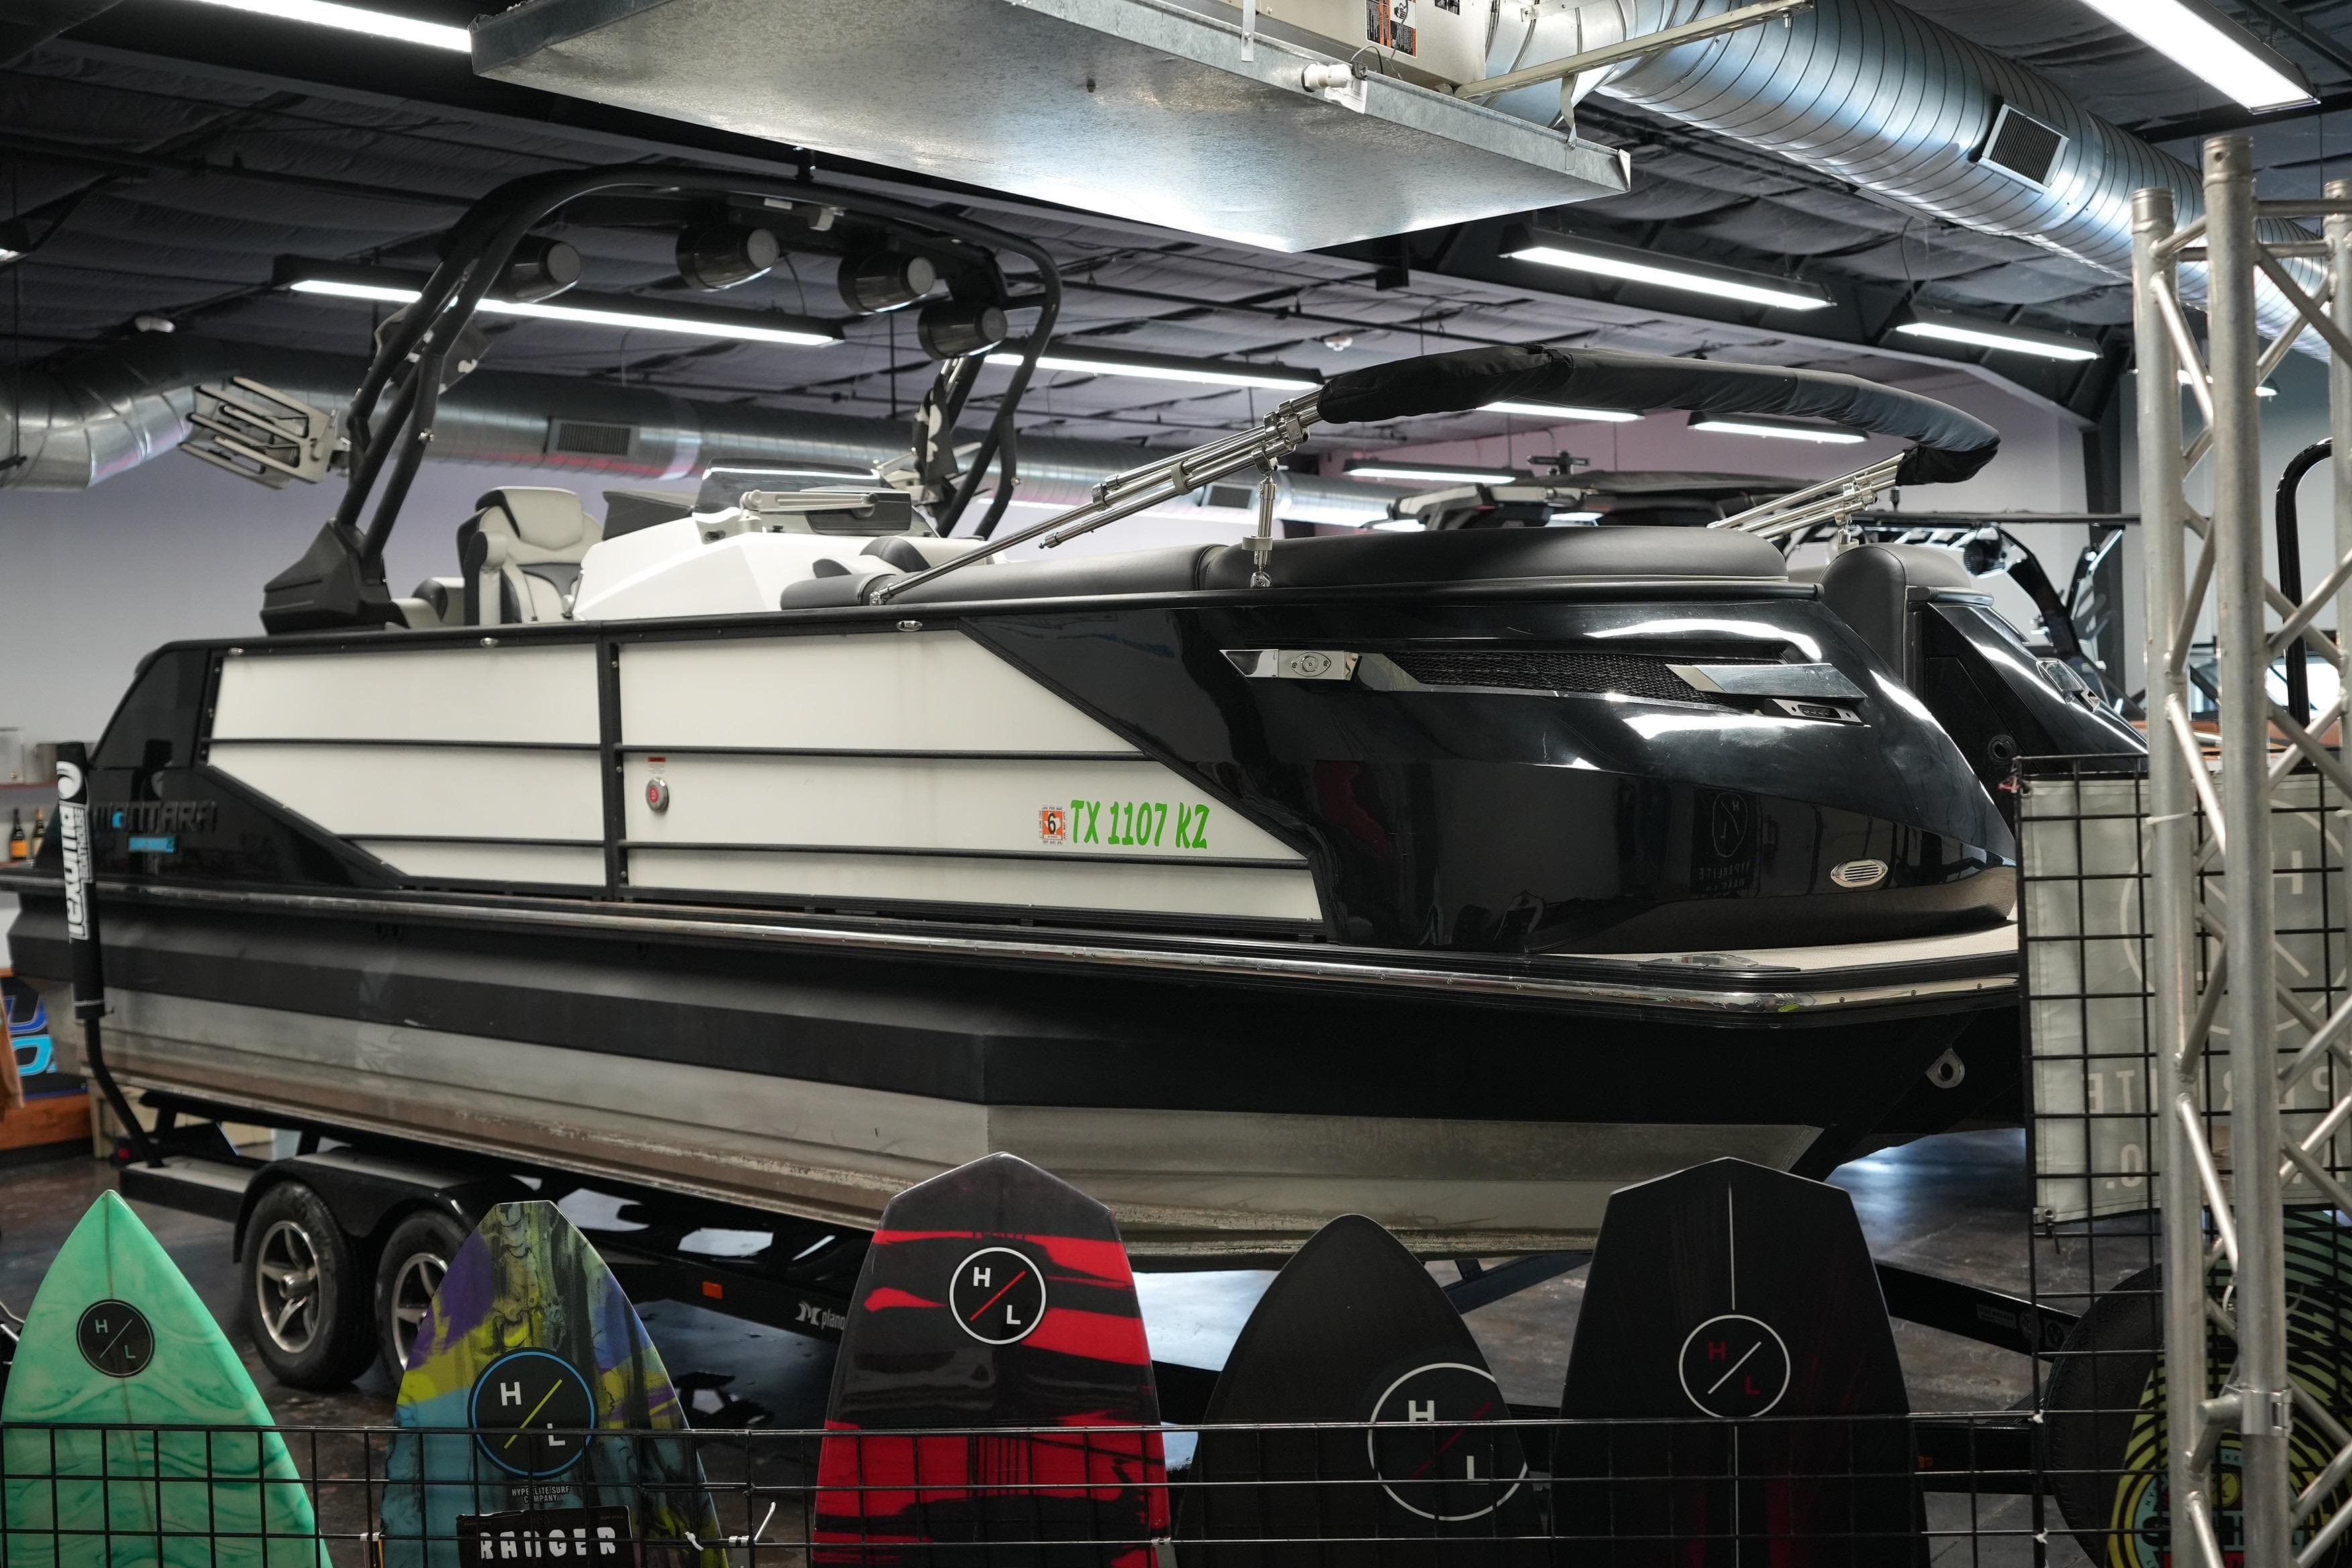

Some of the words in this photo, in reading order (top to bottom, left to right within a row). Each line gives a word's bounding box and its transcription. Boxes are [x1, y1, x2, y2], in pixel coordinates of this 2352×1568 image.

[1048, 812, 1056, 834] 6
[1070, 799, 1101, 844] TX
[1108, 801, 1168, 847] 1107
[972, 1267, 990, 1287] H
[1006, 1305, 1021, 1325] L
[95, 1319, 109, 1334] H
[125, 1345, 136, 1359] L
[1708, 1341, 1726, 1361] H
[500, 1381, 522, 1406] H
[1745, 1376, 1761, 1395] L
[1408, 1400, 1435, 1430] H
[546, 1423, 566, 1447] L
[511, 1486, 550, 1496] HYPELITE
[524, 1494, 558, 1504] CMPANY
[480, 1526, 616, 1560] RANGER
